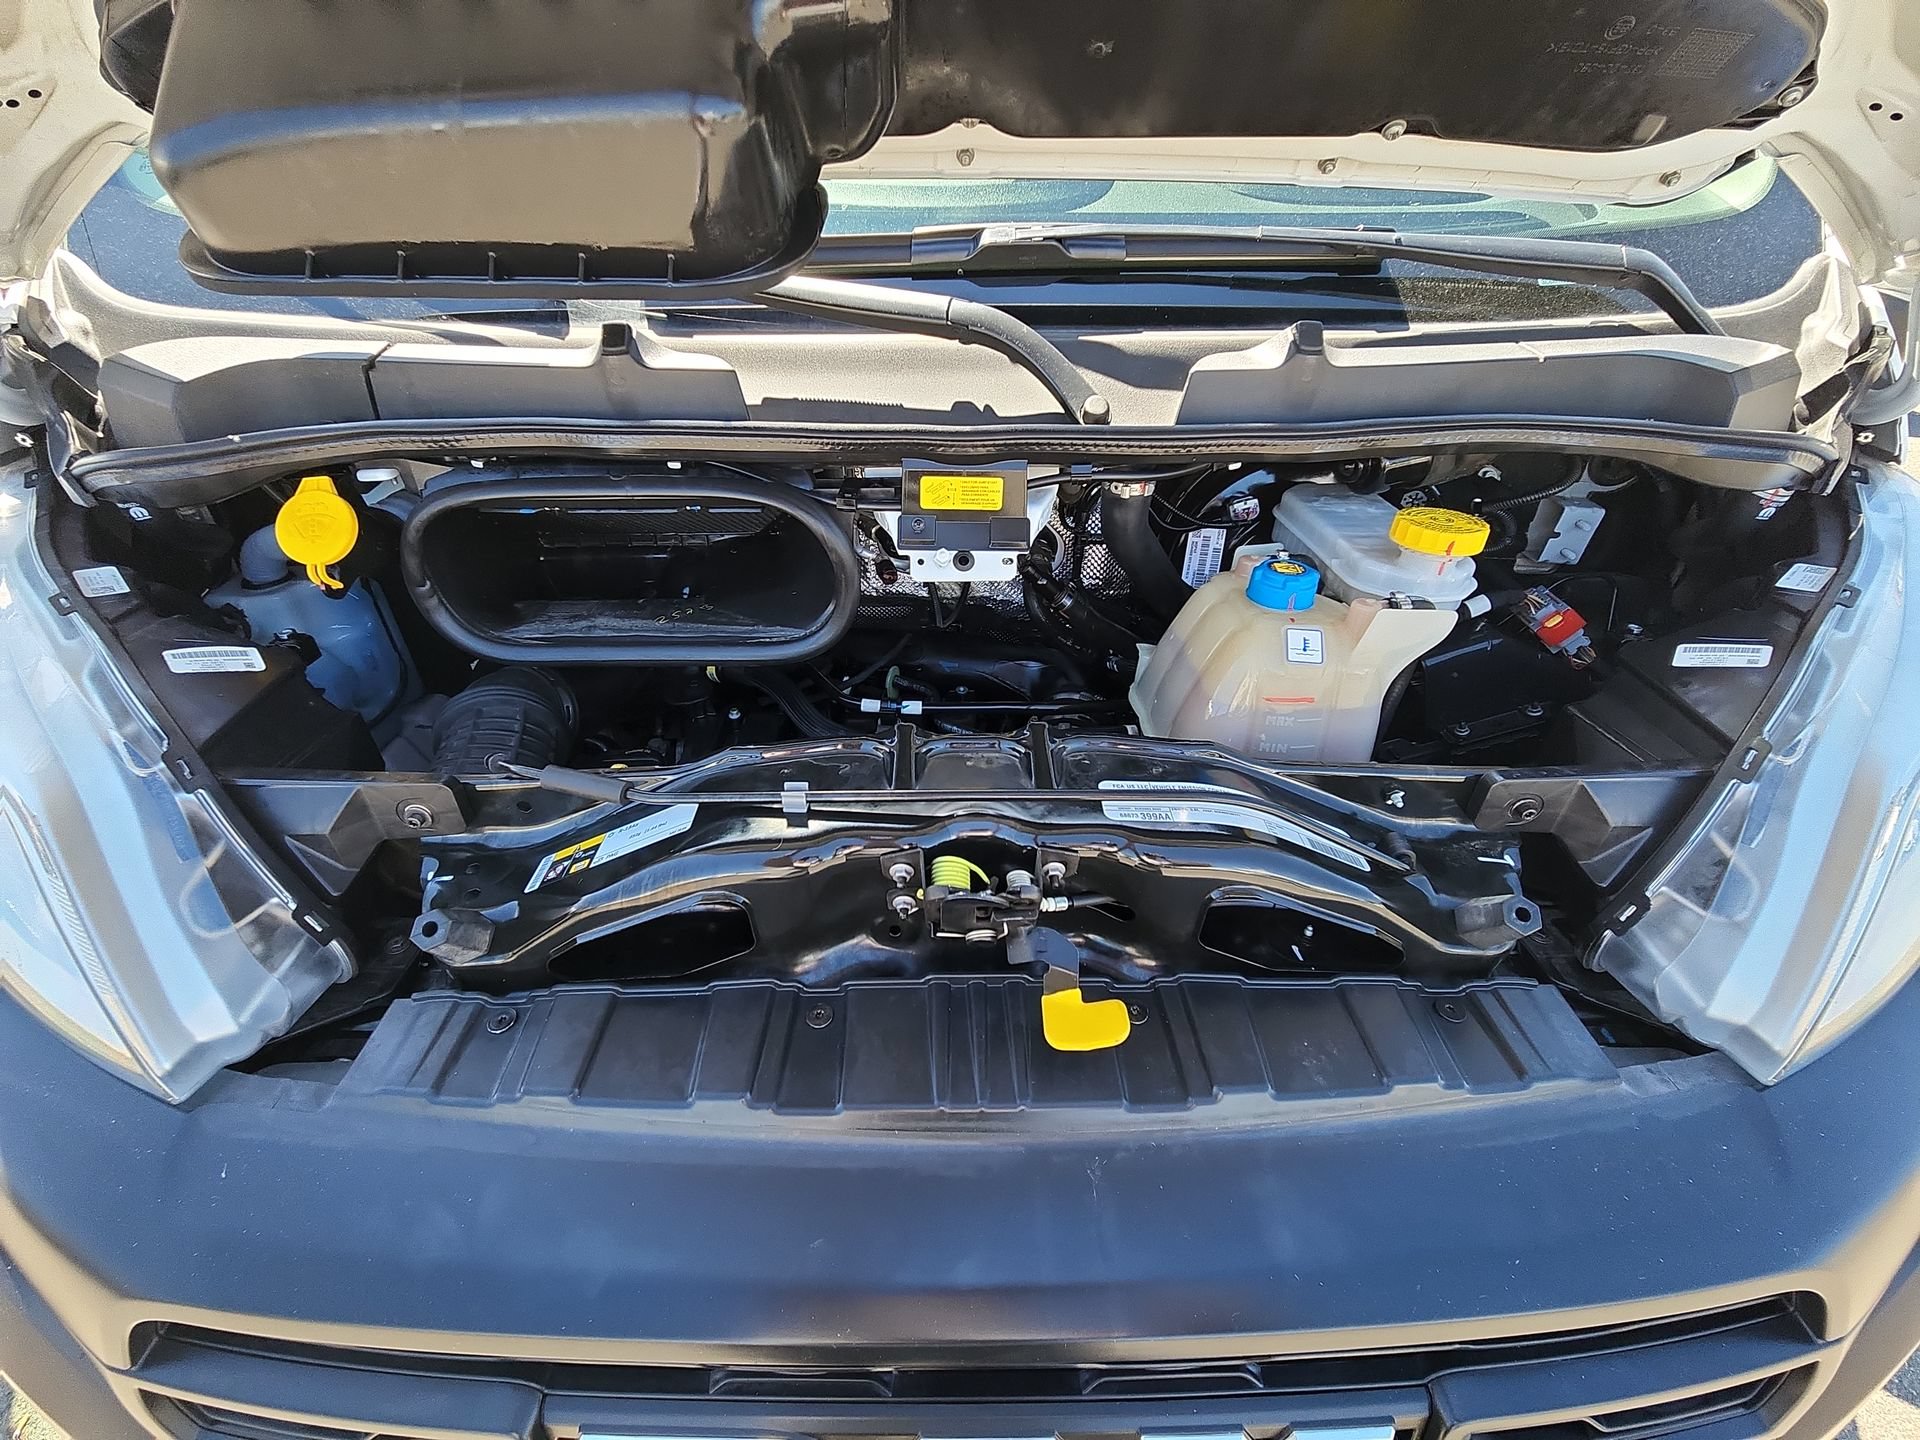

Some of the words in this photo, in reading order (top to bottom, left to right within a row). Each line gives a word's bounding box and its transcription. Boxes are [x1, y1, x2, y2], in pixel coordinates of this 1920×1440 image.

[1265, 715, 1296, 727] MAX
[1258, 742, 1288, 754] MIN
[1140, 811, 1172, 821] 399AA
